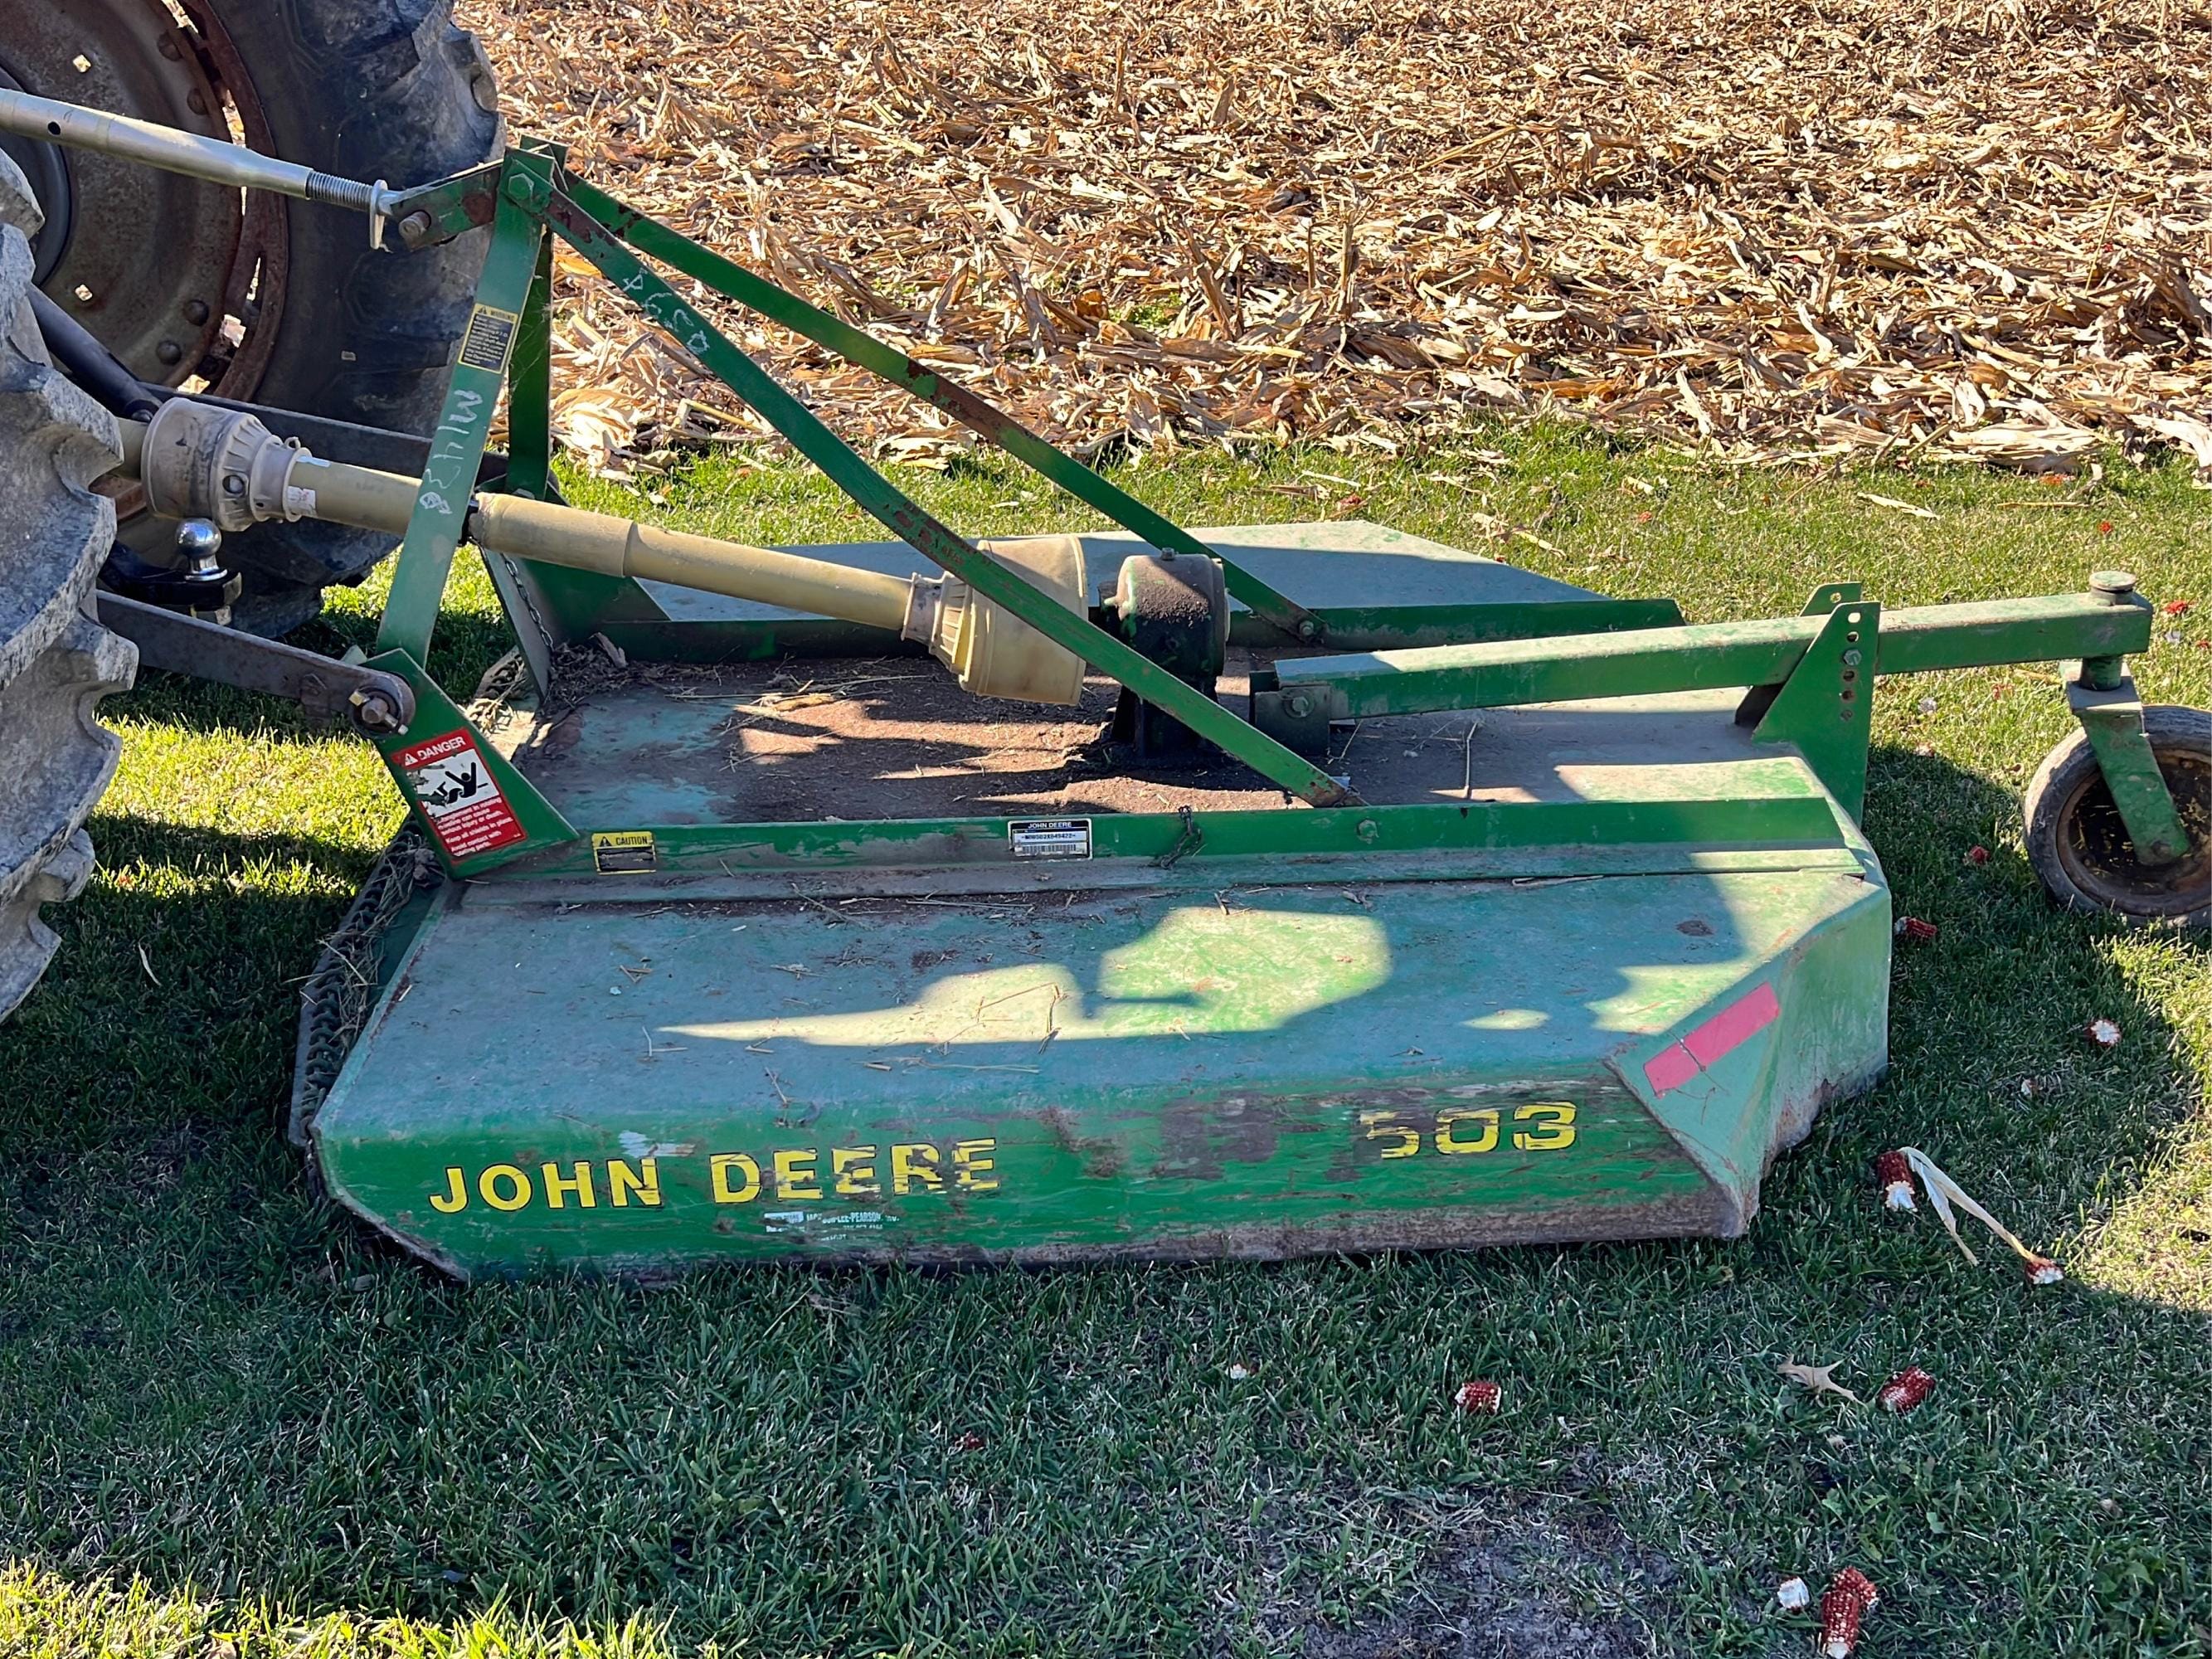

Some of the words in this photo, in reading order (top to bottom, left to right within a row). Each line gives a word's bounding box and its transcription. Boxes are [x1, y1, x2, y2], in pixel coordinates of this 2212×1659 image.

[416, 736, 466, 761] DANGER
[615, 836, 648, 845] CAUTION
[1359, 1102, 1577, 1160] 503
[430, 1156, 664, 1213] JOHN
[709, 1138, 999, 1205] DEERE
